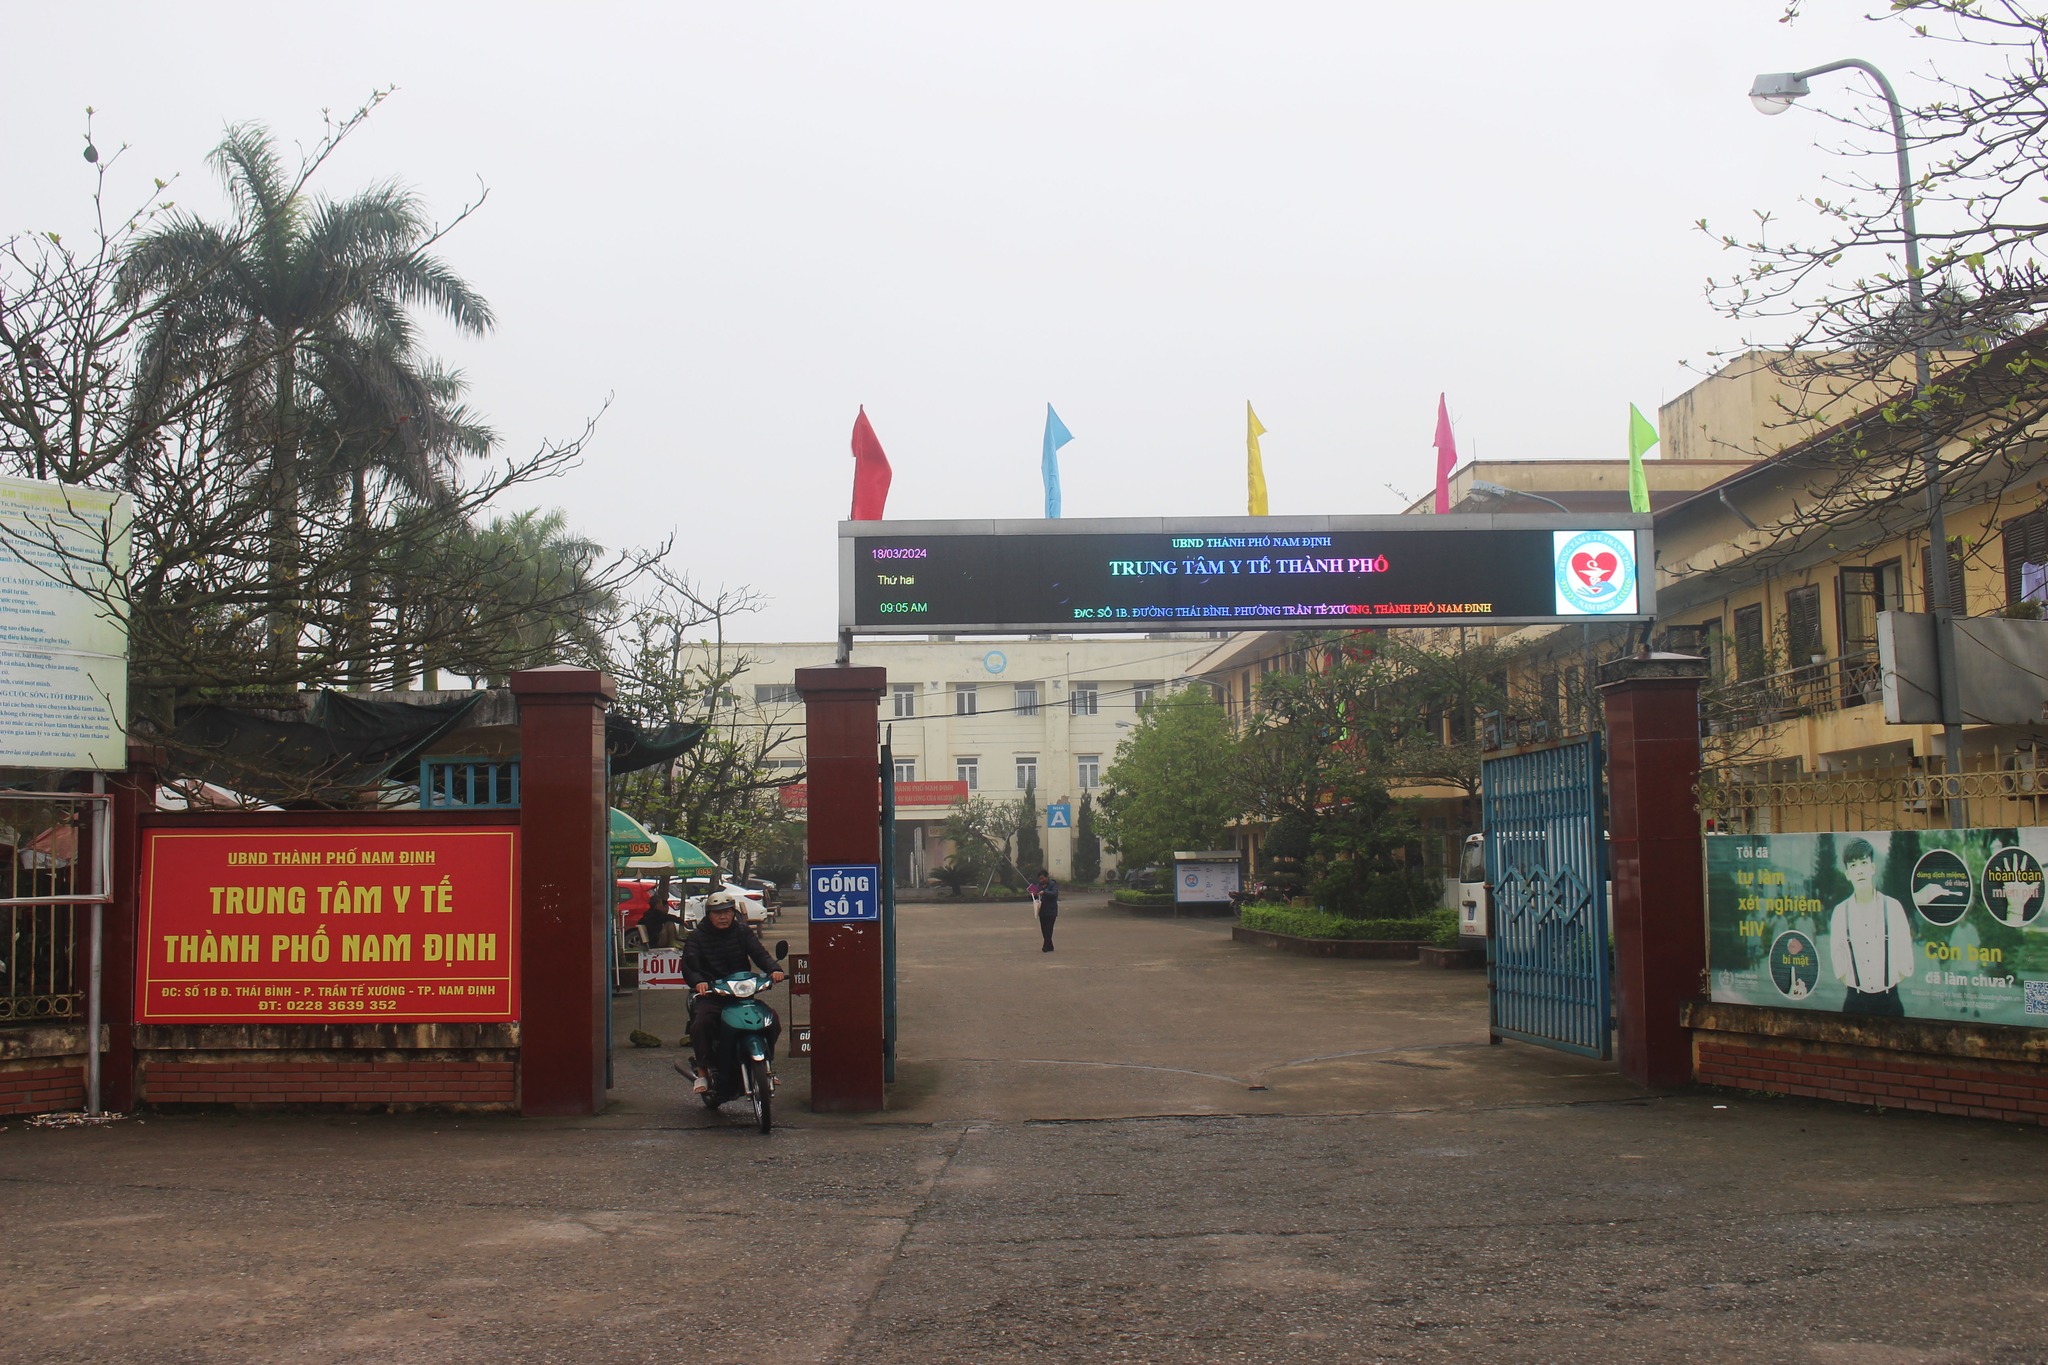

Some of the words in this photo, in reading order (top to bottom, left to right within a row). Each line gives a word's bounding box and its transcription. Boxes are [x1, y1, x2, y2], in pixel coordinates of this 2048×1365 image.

[1172, 538, 1204, 548] UBND
[1206, 536, 1246, 548] THÀNH
[1272, 538, 1300, 547] NAM
[1302, 537, 1332, 548] ĐỊNH
[872, 548, 927, 558] 18/03/2024
[1109, 560, 1178, 576] TRUNG
[1182, 556, 1226, 574] TÂM
[1230, 560, 1242, 574] Y
[1247, 556, 1272, 574] TẾ
[1276, 555, 1344, 573] THÀNH
[878, 575, 897, 584] Thứ
[900, 575, 914, 584] hai
[880, 603, 908, 612] 09:05
[910, 603, 928, 612] AM
[1374, 602, 1412, 614] THÀNH
[1437, 604, 1463, 613] NAM
[1051, 811, 1068, 826] A
[629, 843, 650, 853] 1055
[1736, 846, 1752, 858] Tôi
[1756, 846, 1768, 858] đã
[228, 852, 268, 864] UBND
[273, 849, 321, 864] THÀNH
[326, 848, 358, 864] PHỐ
[362, 852, 394, 864] NAM
[399, 851, 436, 866] ĐỊNH
[696, 868, 712, 876] 1055
[1738, 870, 1754, 888] tự
[1758, 868, 1784, 884] làm
[1932, 872, 1946, 880] dịch
[1988, 868, 2015, 881] hoàn
[818, 870, 869, 892] CỔNG
[210, 886, 306, 914] TRUNG
[317, 880, 382, 914] TÂM
[393, 886, 411, 913] Y
[420, 874, 453, 912] TẾ
[824, 894, 849, 916] SỐ
[856, 900, 864, 914] 1
[1738, 894, 1760, 910] xét
[1765, 895, 1822, 916] nghiệm
[1739, 921, 1764, 936] HIV
[164, 929, 260, 963] THÀNH
[272, 924, 330, 962] PHỐ
[342, 934, 411, 962] NAM
[422, 934, 496, 967] ĐỊNH
[1925, 942, 1961, 960] Còn
[1968, 944, 2002, 966] bạn
[642, 954, 664, 974] LỐI
[668, 954, 683, 974] VÀ
[798, 959, 808, 968] Ra
[1792, 956, 1808, 968] mật
[794, 972, 806, 984] YÊU
[1926, 972, 1941, 984] đã
[1945, 972, 1968, 986] làm
[1972, 974, 2014, 988] chưa?
[162, 988, 181, 996] ĐC:
[184, 984, 200, 997] SỐ
[203, 987, 217, 996] 1B
[220, 987, 232, 996] Đ.
[236, 985, 261, 996] THÁI
[264, 984, 292, 996] BÌNH
[304, 987, 314, 996] P.
[318, 984, 346, 996] TRẦN
[351, 984, 366, 996] TẾ
[368, 985, 405, 996] XƯƠNG
[418, 986, 434, 996] TP.
[439, 986, 464, 995] NAM
[468, 986, 496, 997] ĐỊNH
[258, 1002, 282, 1010] ĐT:
[286, 1001, 322, 1010] 0228
[328, 1001, 364, 1010] 3639
[370, 1000, 396, 1010] 352
[802, 1044, 811, 1052] QU
